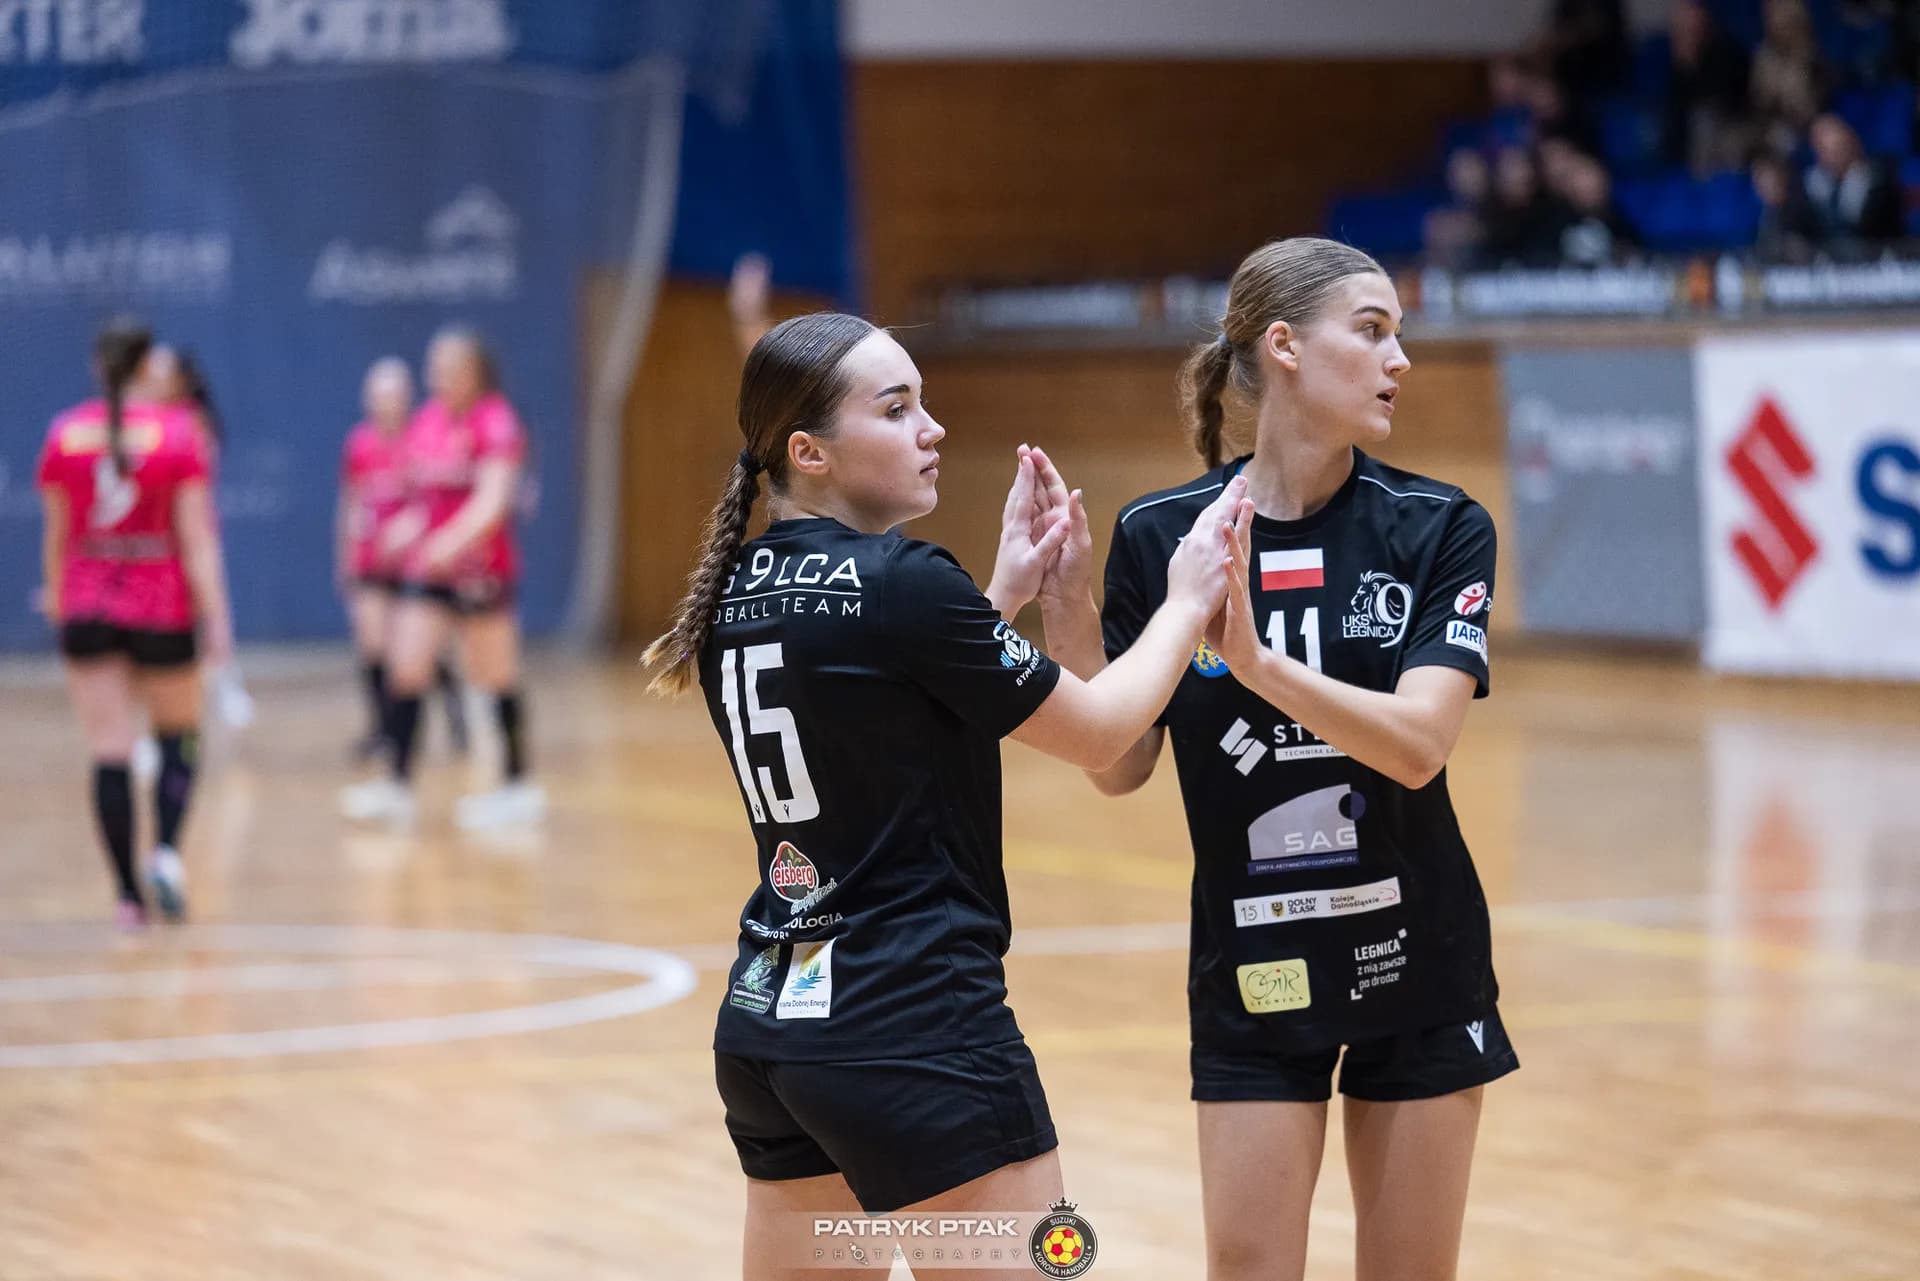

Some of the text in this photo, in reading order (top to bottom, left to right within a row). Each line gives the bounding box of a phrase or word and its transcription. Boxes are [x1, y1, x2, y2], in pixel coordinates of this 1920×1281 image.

[781, 597, 862, 617] TEAM
[1342, 615, 1370, 627] UKS
[1266, 607, 1323, 673] 11
[1343, 625, 1396, 638] LEGNICA
[1015, 667, 1033, 687] GYM
[721, 642, 820, 824] 15
[1273, 723, 1321, 744] ST
[1284, 826, 1357, 852] SAG
[773, 861, 816, 889] eisberg
[1288, 897, 1317, 907] DOLNY
[1330, 895, 1355, 903] Koleje
[1354, 938, 1401, 961] LEGNICA
[1357, 966, 1363, 976] z
[1379, 955, 1407, 971] zawsze
[1358, 971, 1400, 991] po drodze
